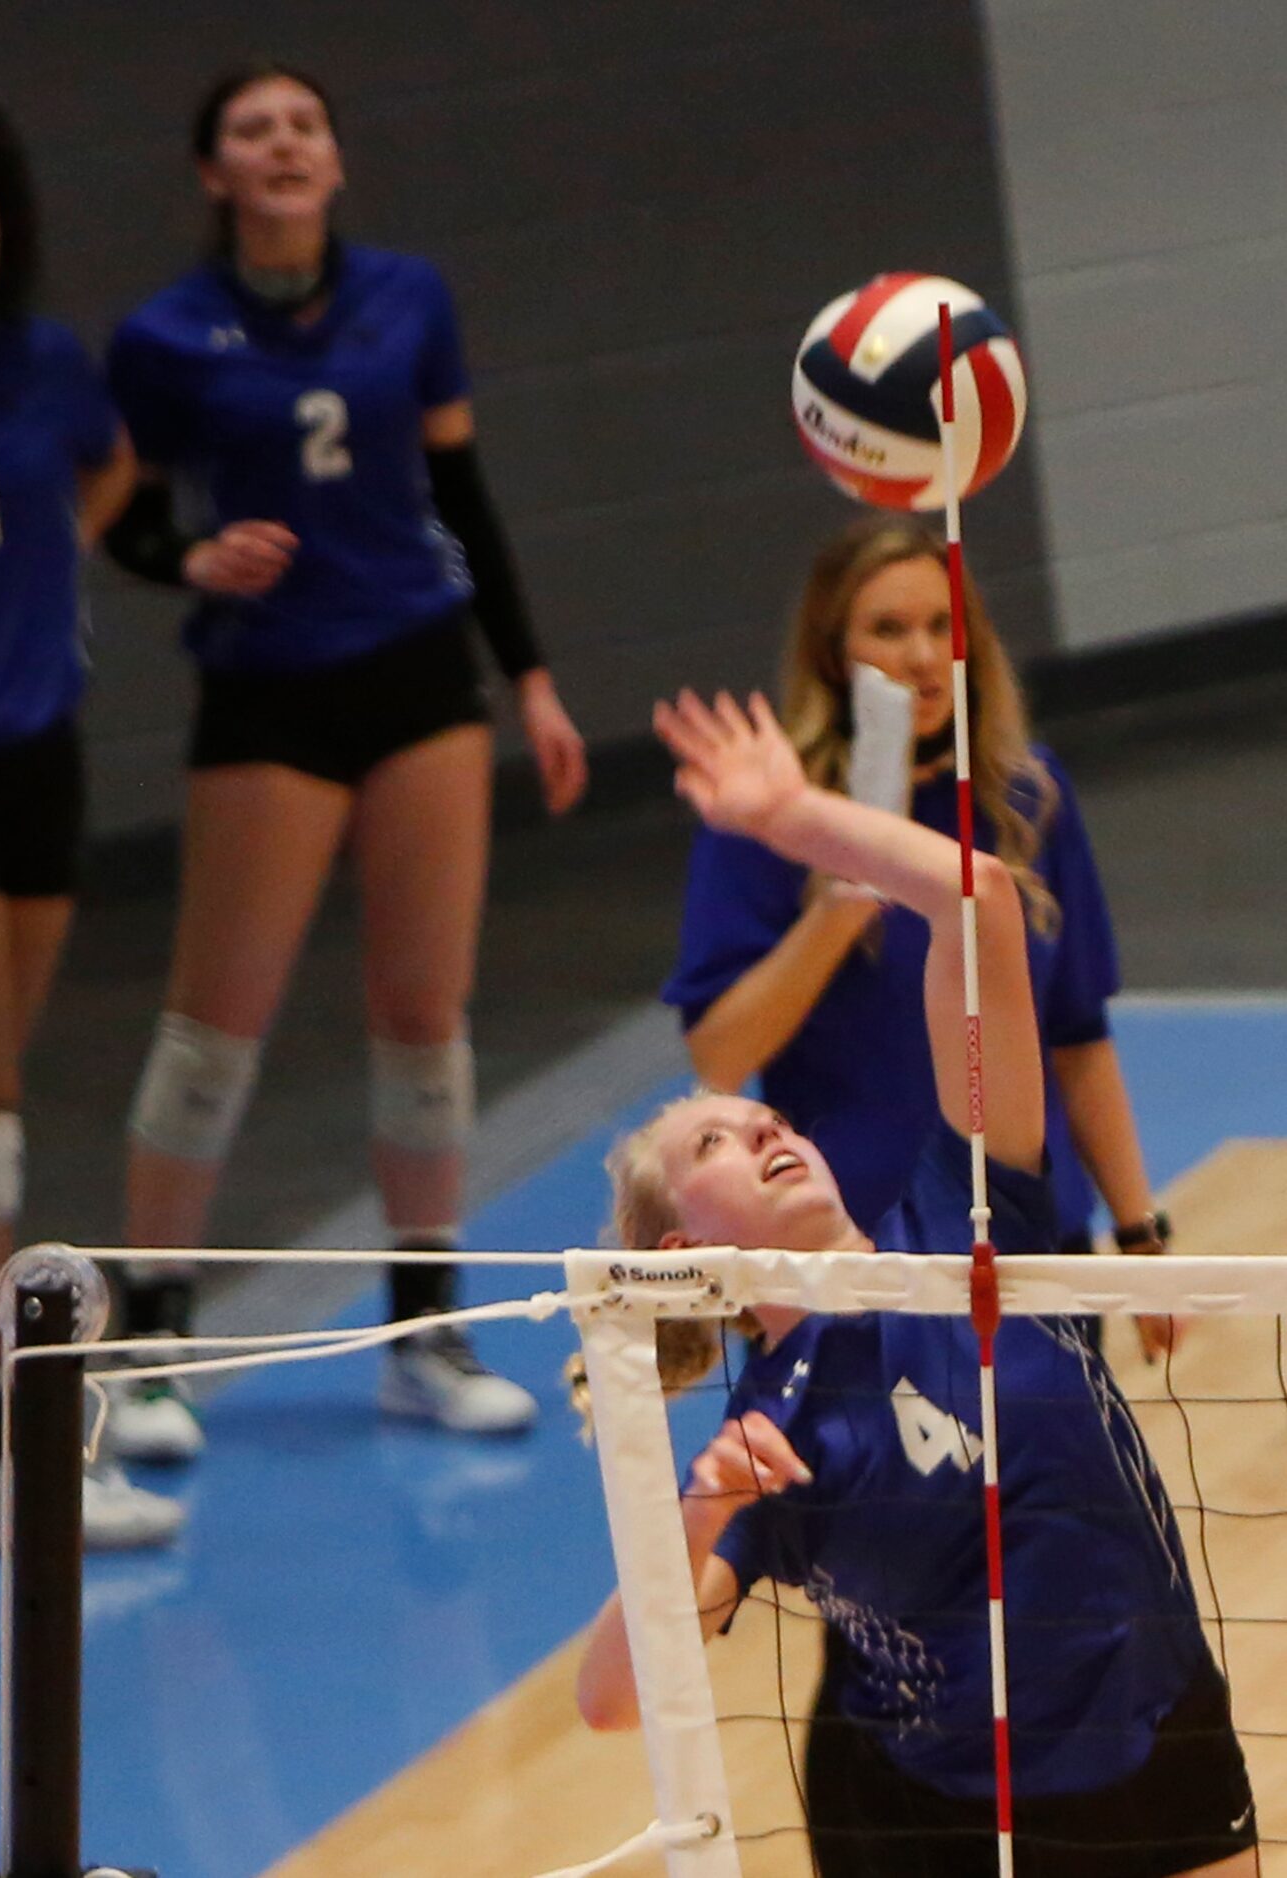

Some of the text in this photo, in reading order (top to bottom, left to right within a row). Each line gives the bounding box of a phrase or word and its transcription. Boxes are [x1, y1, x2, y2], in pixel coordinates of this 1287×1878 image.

[294, 388, 353, 482] 2
[629, 1265, 703, 1282] Senoh
[890, 1376, 985, 1476] 4
